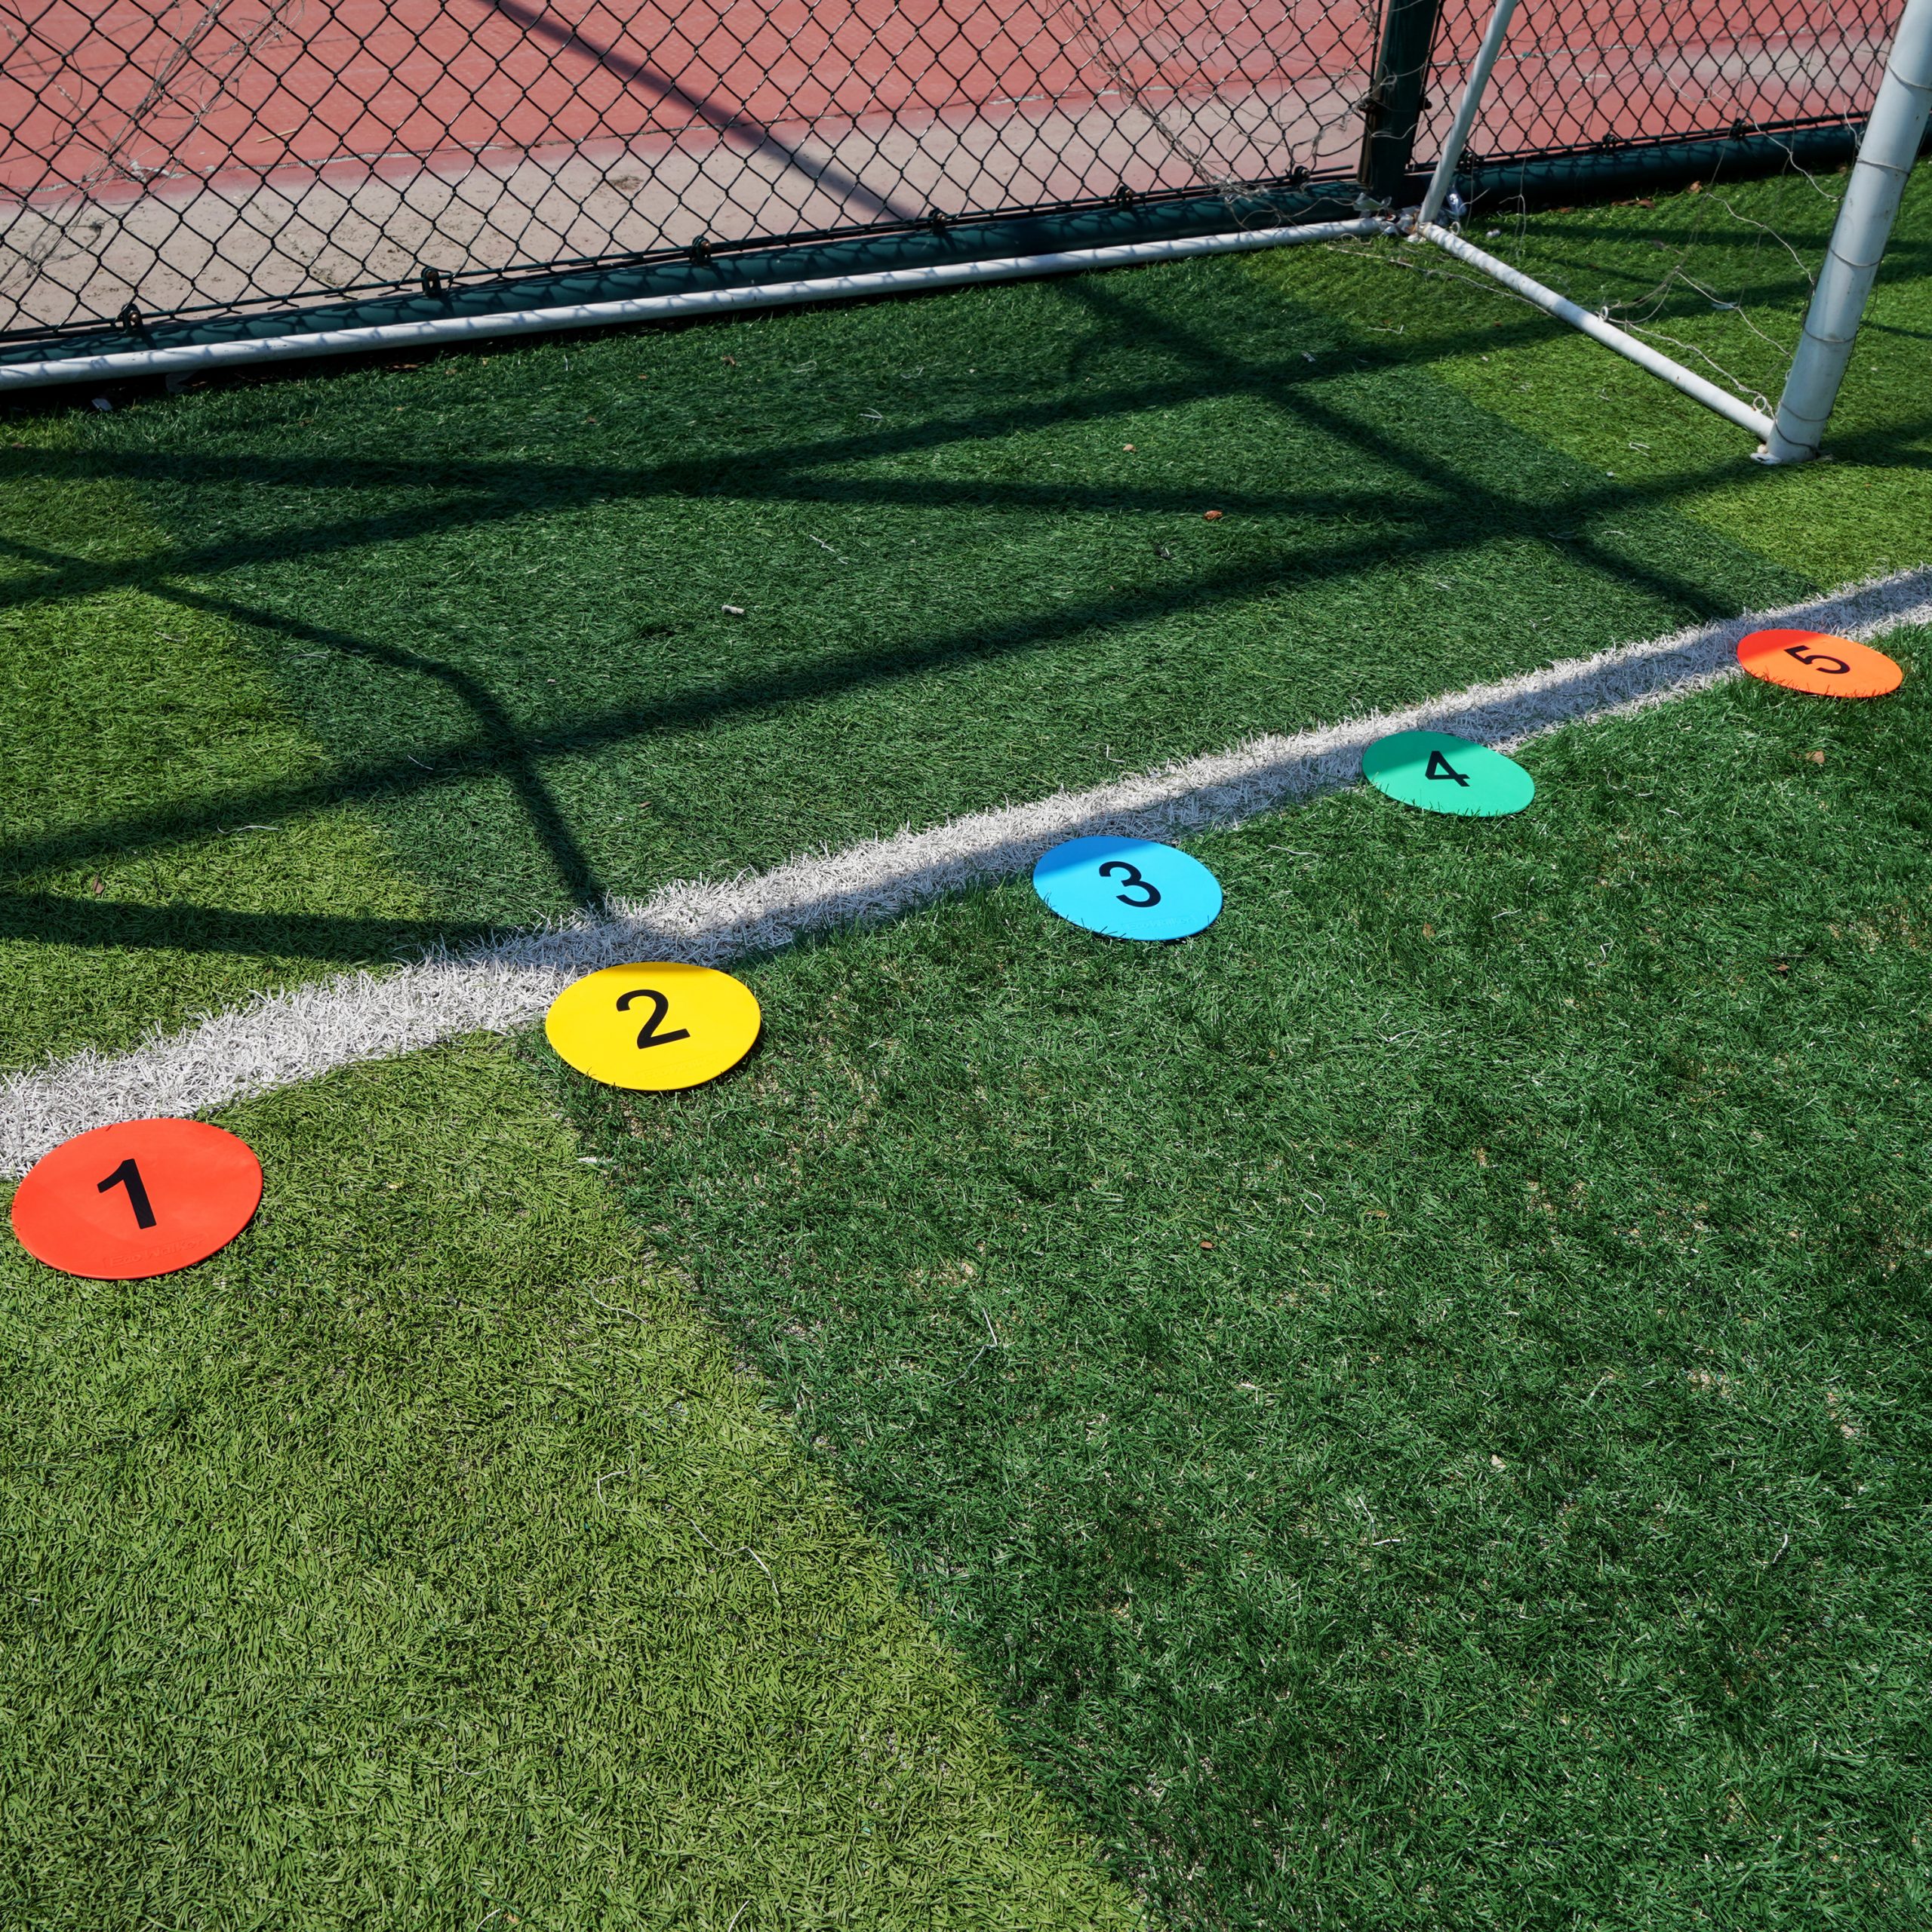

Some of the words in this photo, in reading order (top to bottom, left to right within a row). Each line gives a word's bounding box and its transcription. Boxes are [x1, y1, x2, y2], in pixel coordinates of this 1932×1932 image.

[1783, 645, 1850, 675] 5
[1425, 750, 1471, 787] 4
[1098, 860, 1161, 908] 3
[616, 989, 691, 1050] 2
[97, 1158, 157, 1229] 1
